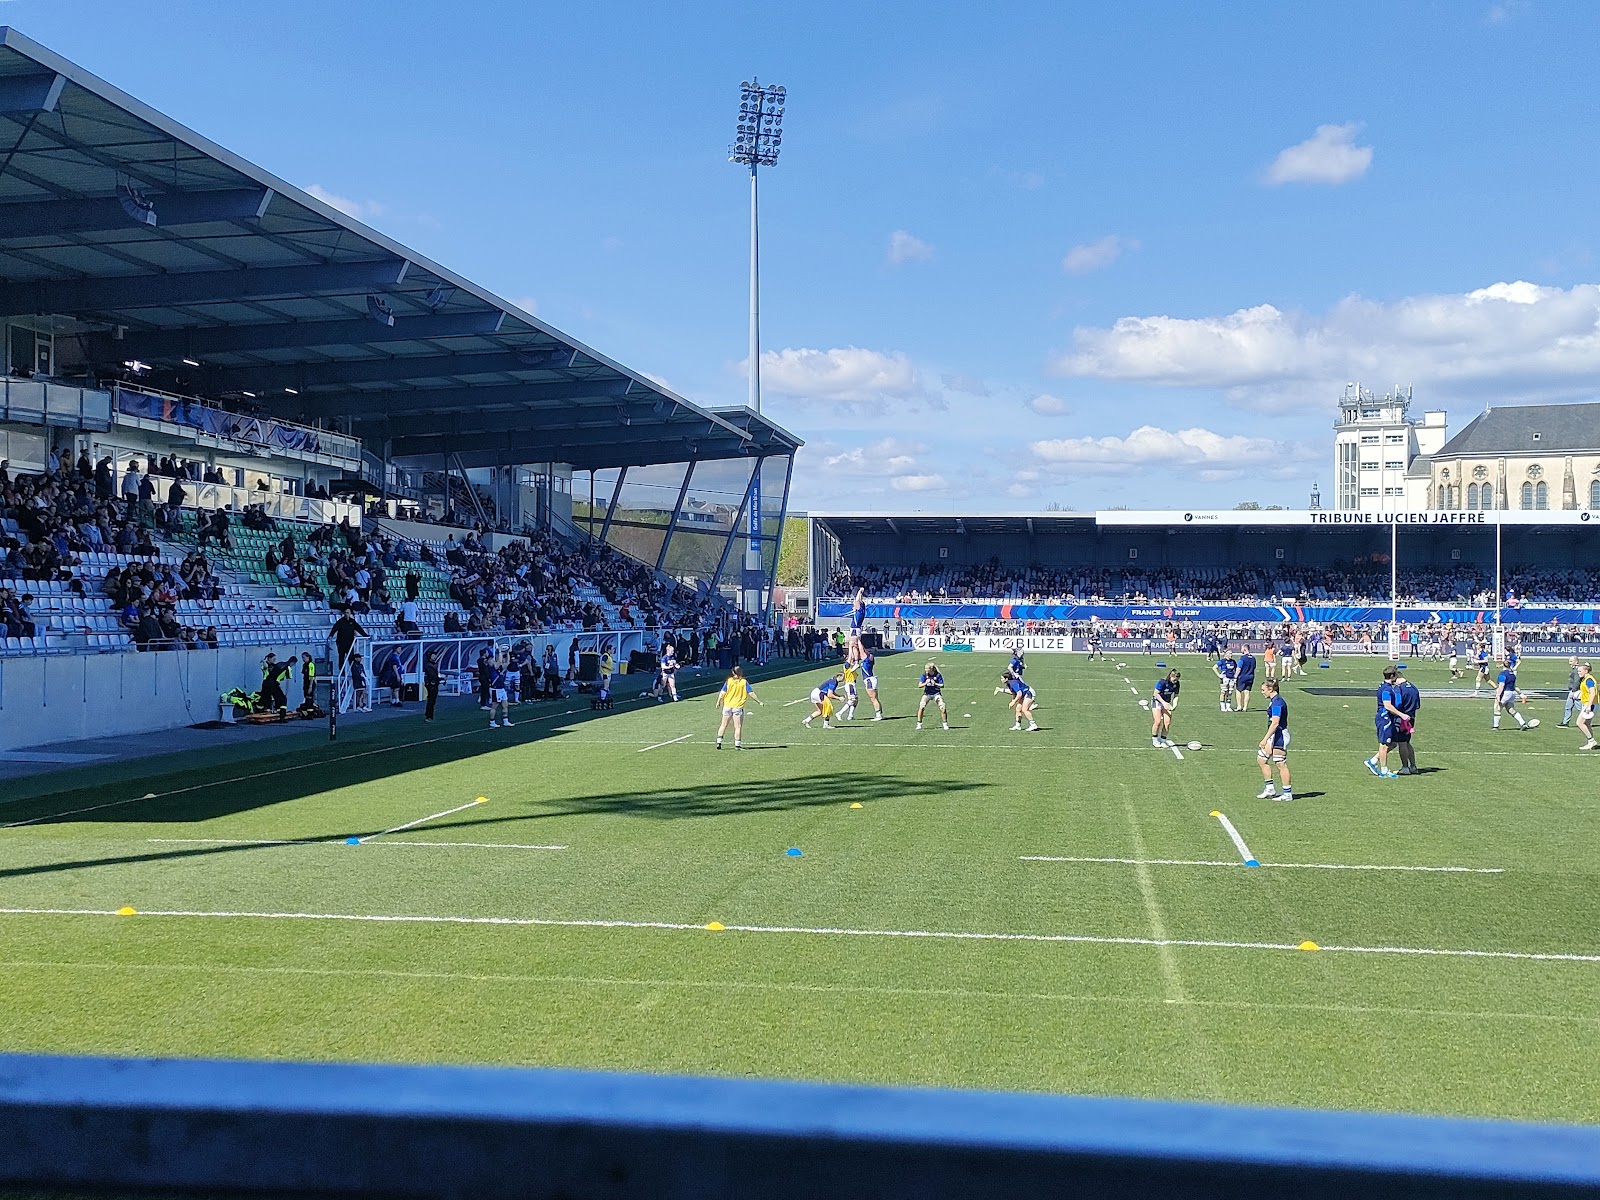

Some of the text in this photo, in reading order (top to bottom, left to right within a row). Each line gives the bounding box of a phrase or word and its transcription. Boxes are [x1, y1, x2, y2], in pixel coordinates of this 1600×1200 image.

[1310, 511, 1485, 523] TRIBUNE LUCIEN JAFFRÉ
[901, 637, 975, 648] MOBIZE
[989, 638, 1064, 649] MOBILIZE
